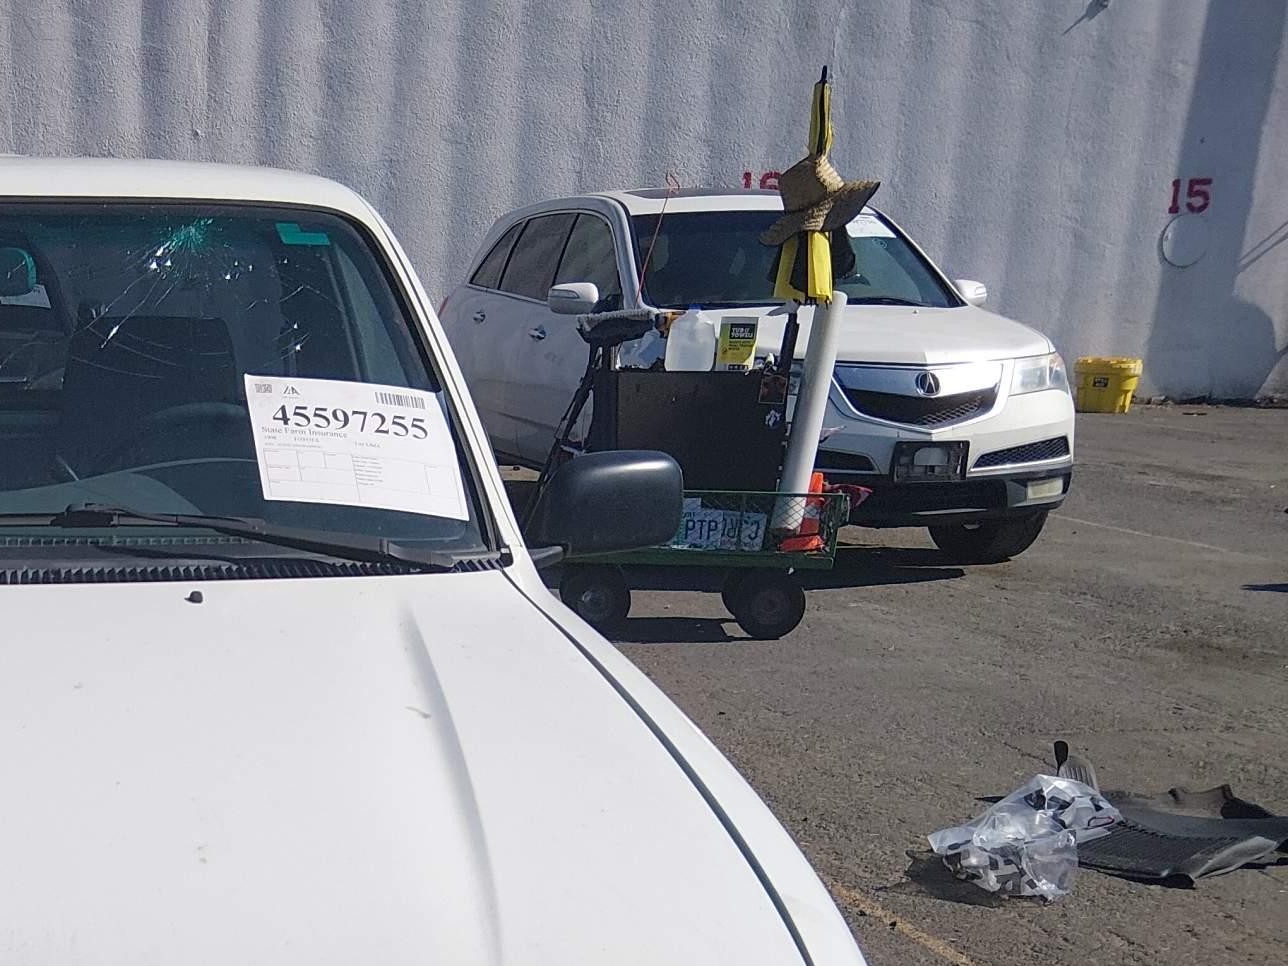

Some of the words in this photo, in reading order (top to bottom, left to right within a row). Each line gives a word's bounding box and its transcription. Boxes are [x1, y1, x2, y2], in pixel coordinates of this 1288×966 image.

[1167, 178, 1213, 214] 15
[261, 426, 283, 434] State
[284, 427, 307, 435] Farm
[308, 428, 348, 439] Insurance
[272, 404, 428, 440] 45597255
